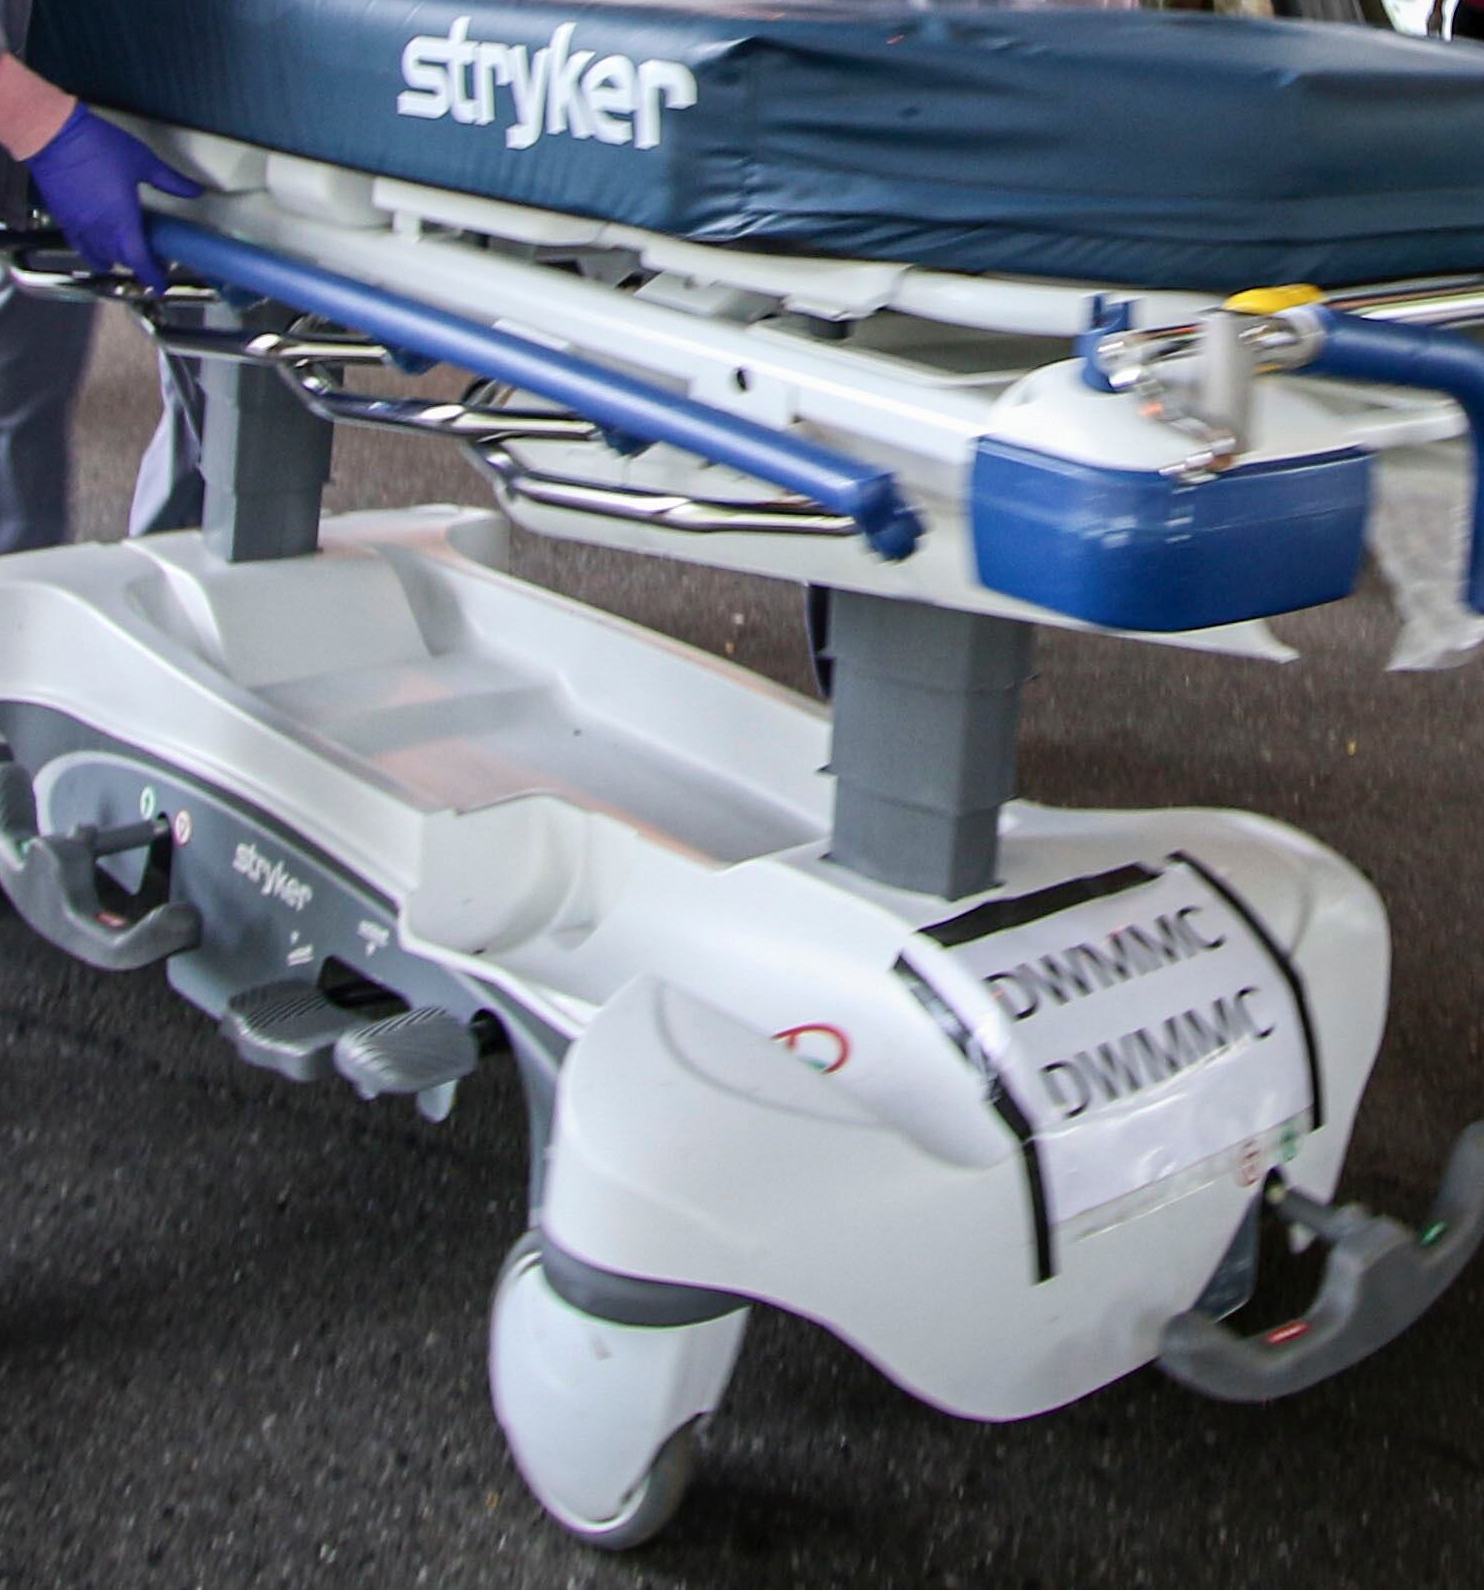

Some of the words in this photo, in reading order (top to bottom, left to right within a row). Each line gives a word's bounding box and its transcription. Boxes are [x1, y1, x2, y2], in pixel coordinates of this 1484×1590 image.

[397, 15, 697, 150] stryker
[233, 843, 313, 912] stryker
[982, 906, 1226, 1021] DWMMC
[1039, 986, 1276, 1118] DWMMC
